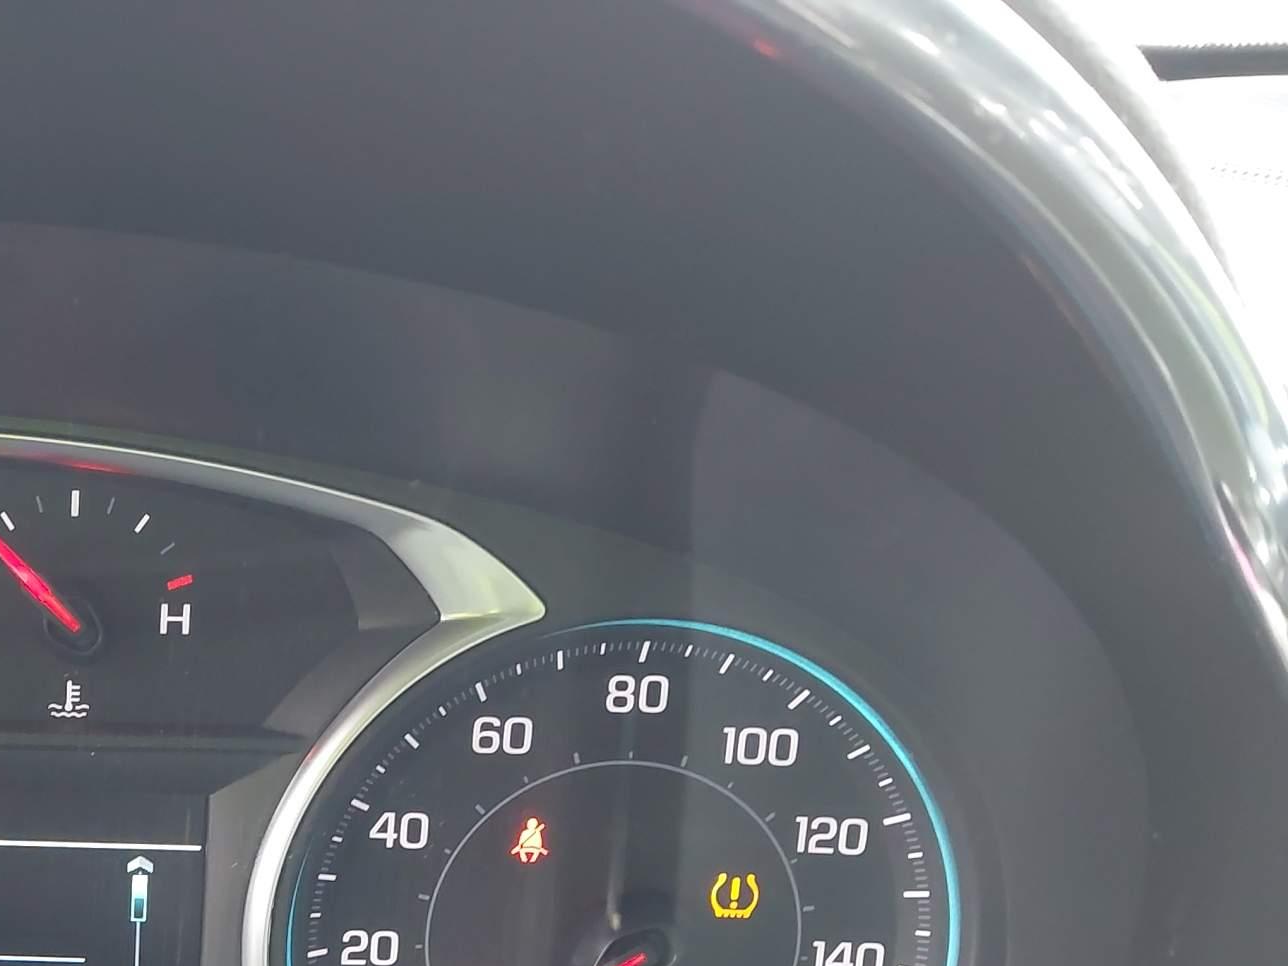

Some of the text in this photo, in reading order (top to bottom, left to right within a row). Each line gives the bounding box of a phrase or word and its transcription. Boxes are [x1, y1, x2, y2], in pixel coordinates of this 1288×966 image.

[159, 603, 192, 636] H
[605, 675, 669, 713] 80
[471, 717, 534, 755] 60
[722, 727, 799, 766] 100
[369, 812, 429, 850] 40
[794, 816, 869, 855] 120
[340, 930, 399, 966] 20
